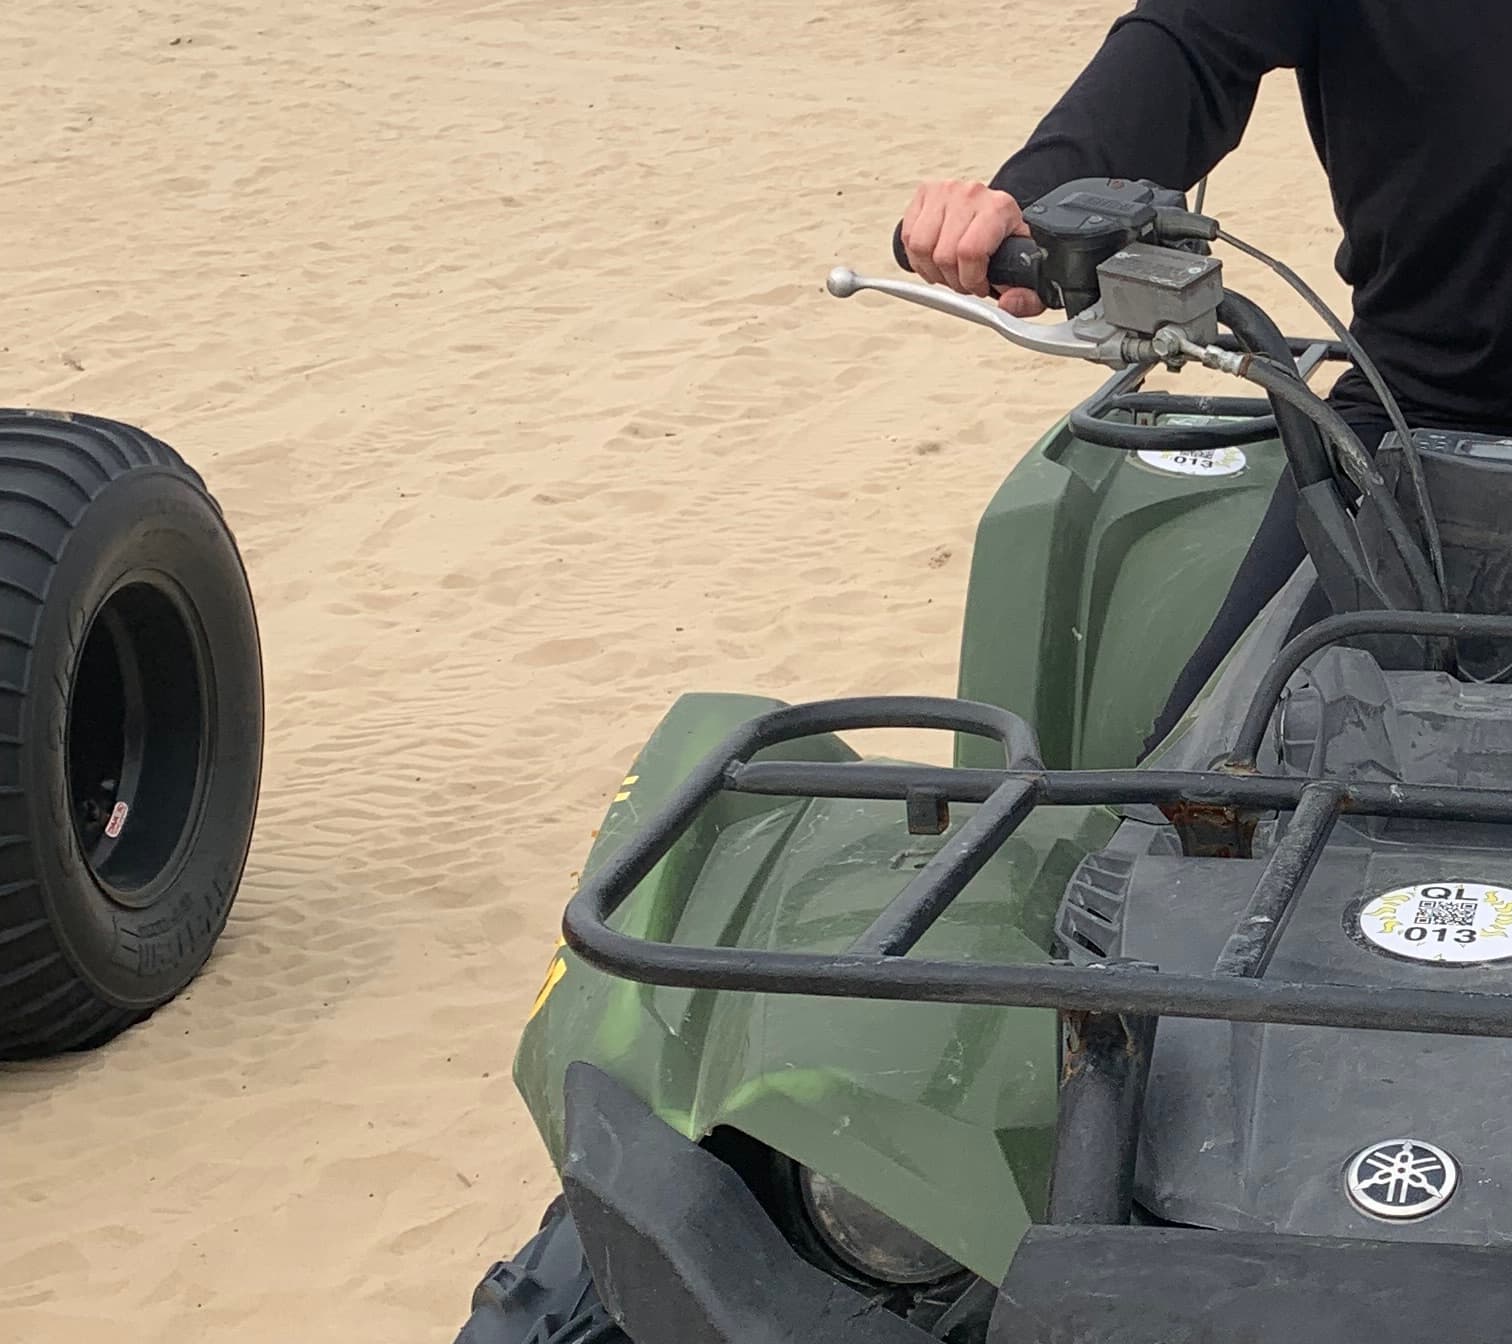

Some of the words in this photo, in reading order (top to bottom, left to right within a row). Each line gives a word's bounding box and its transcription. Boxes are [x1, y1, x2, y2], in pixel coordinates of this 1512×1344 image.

[1174, 456, 1213, 468] 013
[1421, 886, 1478, 902] QL
[1404, 926, 1477, 944] 013
